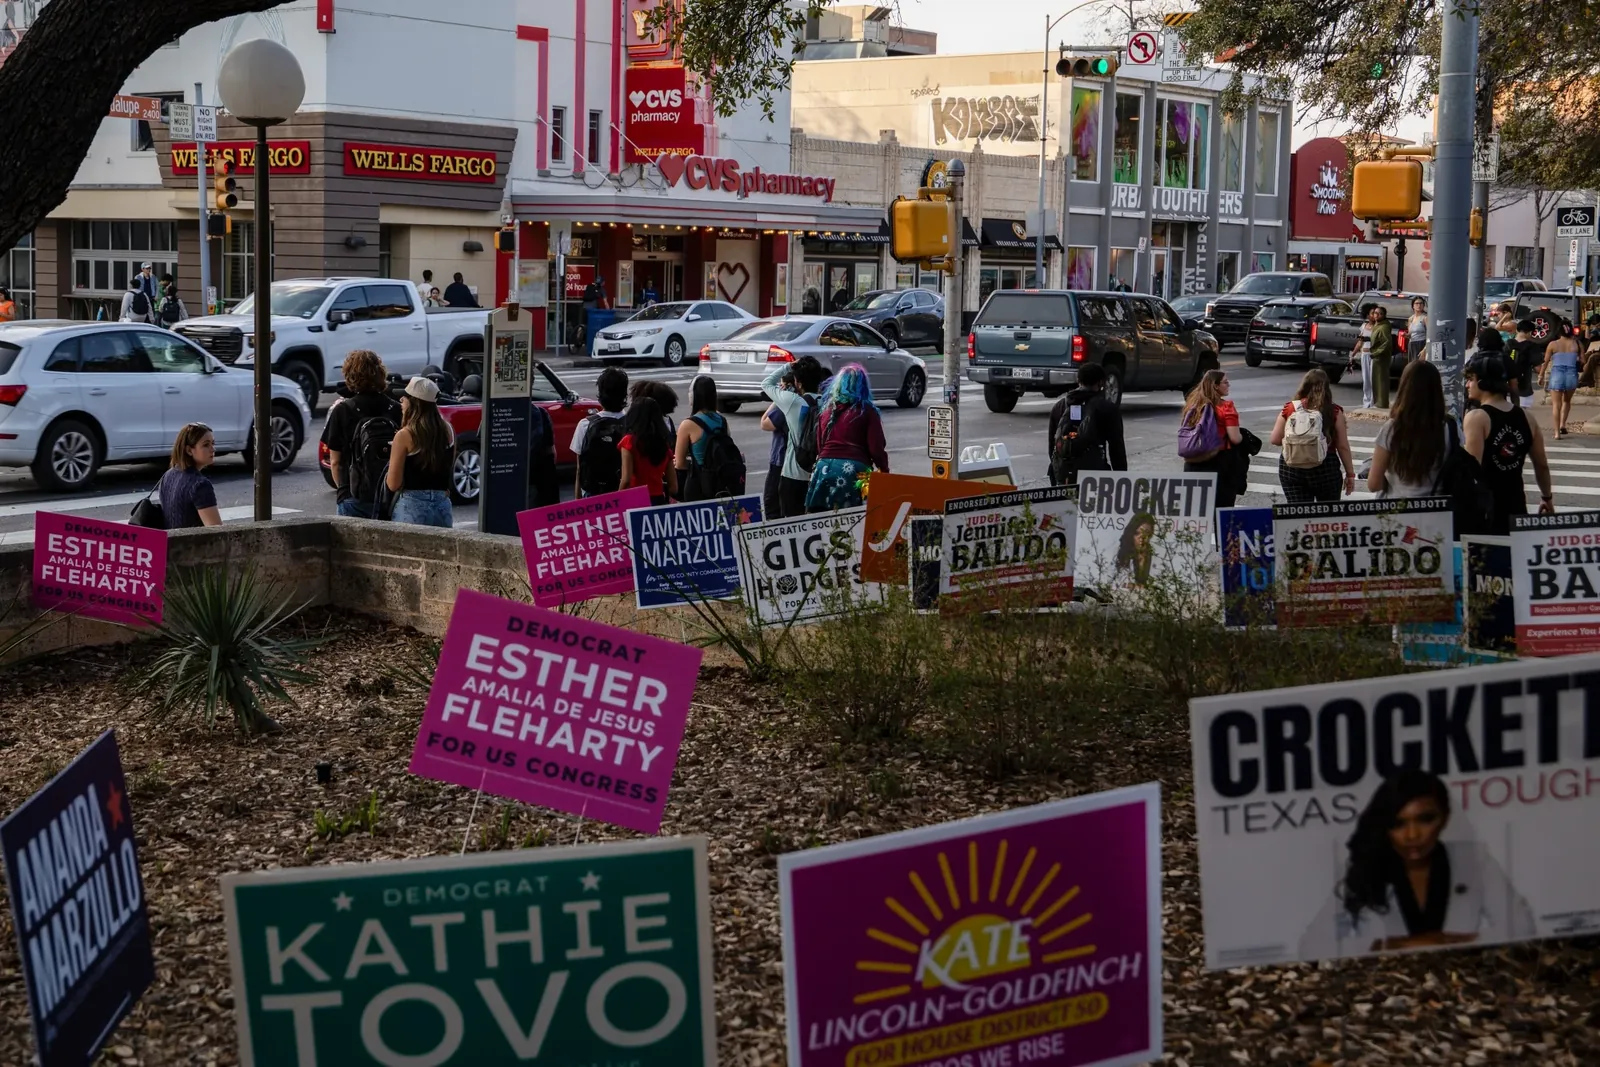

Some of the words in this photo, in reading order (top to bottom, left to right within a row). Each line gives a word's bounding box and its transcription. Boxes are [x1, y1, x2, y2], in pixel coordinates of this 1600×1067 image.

[151, 100, 159, 109] ST
[646, 88, 682, 108] CVS
[143, 110, 160, 119] 2400
[631, 110, 680, 124] pharmacy
[352, 149, 425, 172] WELLS
[430, 154, 495, 176] FARGO
[634, 147, 664, 156] WELLS
[665, 147, 695, 156] FARGO
[685, 155, 741, 192] CVS
[743, 166, 836, 202] pharmacy
[566, 273, 581, 281] open
[566, 283, 573, 291] 24
[547, 499, 620, 522] DEMOCRAT
[948, 498, 988, 510] ENDORSED
[990, 496, 1000, 505] BY
[1002, 491, 1044, 503] GOVERNOR
[1046, 488, 1077, 499] ABBOTT
[1080, 477, 1213, 517] CROCKETT
[1277, 505, 1329, 516] ENDORSED
[1333, 504, 1345, 513] BY
[1407, 499, 1448, 509] ABBOTT
[64, 522, 138, 542] DEMOCRAT
[641, 506, 730, 541] AMANDA
[746, 523, 808, 540] DEMOCRATIC
[812, 515, 862, 530] SOCIALIST
[967, 513, 1001, 527] JUDGE
[1079, 515, 1125, 530] TEXAS
[1303, 522, 1349, 533] JUDGE
[1516, 514, 1580, 527] ENDORSED
[1583, 513, 1599, 524] BY
[48, 533, 153, 568] ESTHER
[541, 544, 585, 560] AMALIA
[589, 539, 604, 550] DE
[763, 531, 853, 570] GIGS
[950, 532, 1067, 572] BALIDO
[1286, 526, 1399, 551] Jennifer
[49, 555, 93, 570] AMALIA
[97, 563, 112, 573] DE
[116, 566, 150, 579] JESUS
[1288, 546, 1441, 580] BALIDO
[42, 564, 156, 597] FLEHARTY
[537, 581, 563, 594] FOR
[568, 577, 586, 588] US
[38, 585, 63, 596] FOR
[68, 590, 83, 599] US
[89, 594, 157, 613] CONGRESS
[803, 596, 817, 605] TX
[1534, 606, 1576, 614] Republican
[507, 616, 646, 664] DEMOCRAT
[1527, 628, 1578, 639] Experience
[1579, 627, 1596, 635] You
[465, 634, 668, 717] ESTHER
[462, 676, 545, 711] AMALIA
[554, 698, 583, 720] DE
[588, 708, 656, 738] JESUS
[441, 693, 664, 773] FLEHARTY
[427, 732, 476, 758] FOR
[486, 746, 517, 768] US
[526, 757, 658, 804] CONGRESS
[1212, 793, 1360, 835] TEXAS
[17, 783, 109, 933] AMANDA
[383, 876, 549, 907] DEMOCRAT
[28, 837, 140, 1020] MARZULLO
[265, 892, 674, 986] KATHIE
[914, 917, 1036, 992] KATE
[261, 959, 688, 1067] TOVO
[807, 951, 1143, 1050] LINCOLN-GOLDFINCH
[856, 1042, 897, 1066] FOR
[902, 1024, 973, 1059] HOUSE
[979, 1003, 1063, 1041] DISTRICT
[1065, 996, 1102, 1019] 50
[979, 1045, 1013, 1067] WE
[1018, 1033, 1066, 1060] RISE
